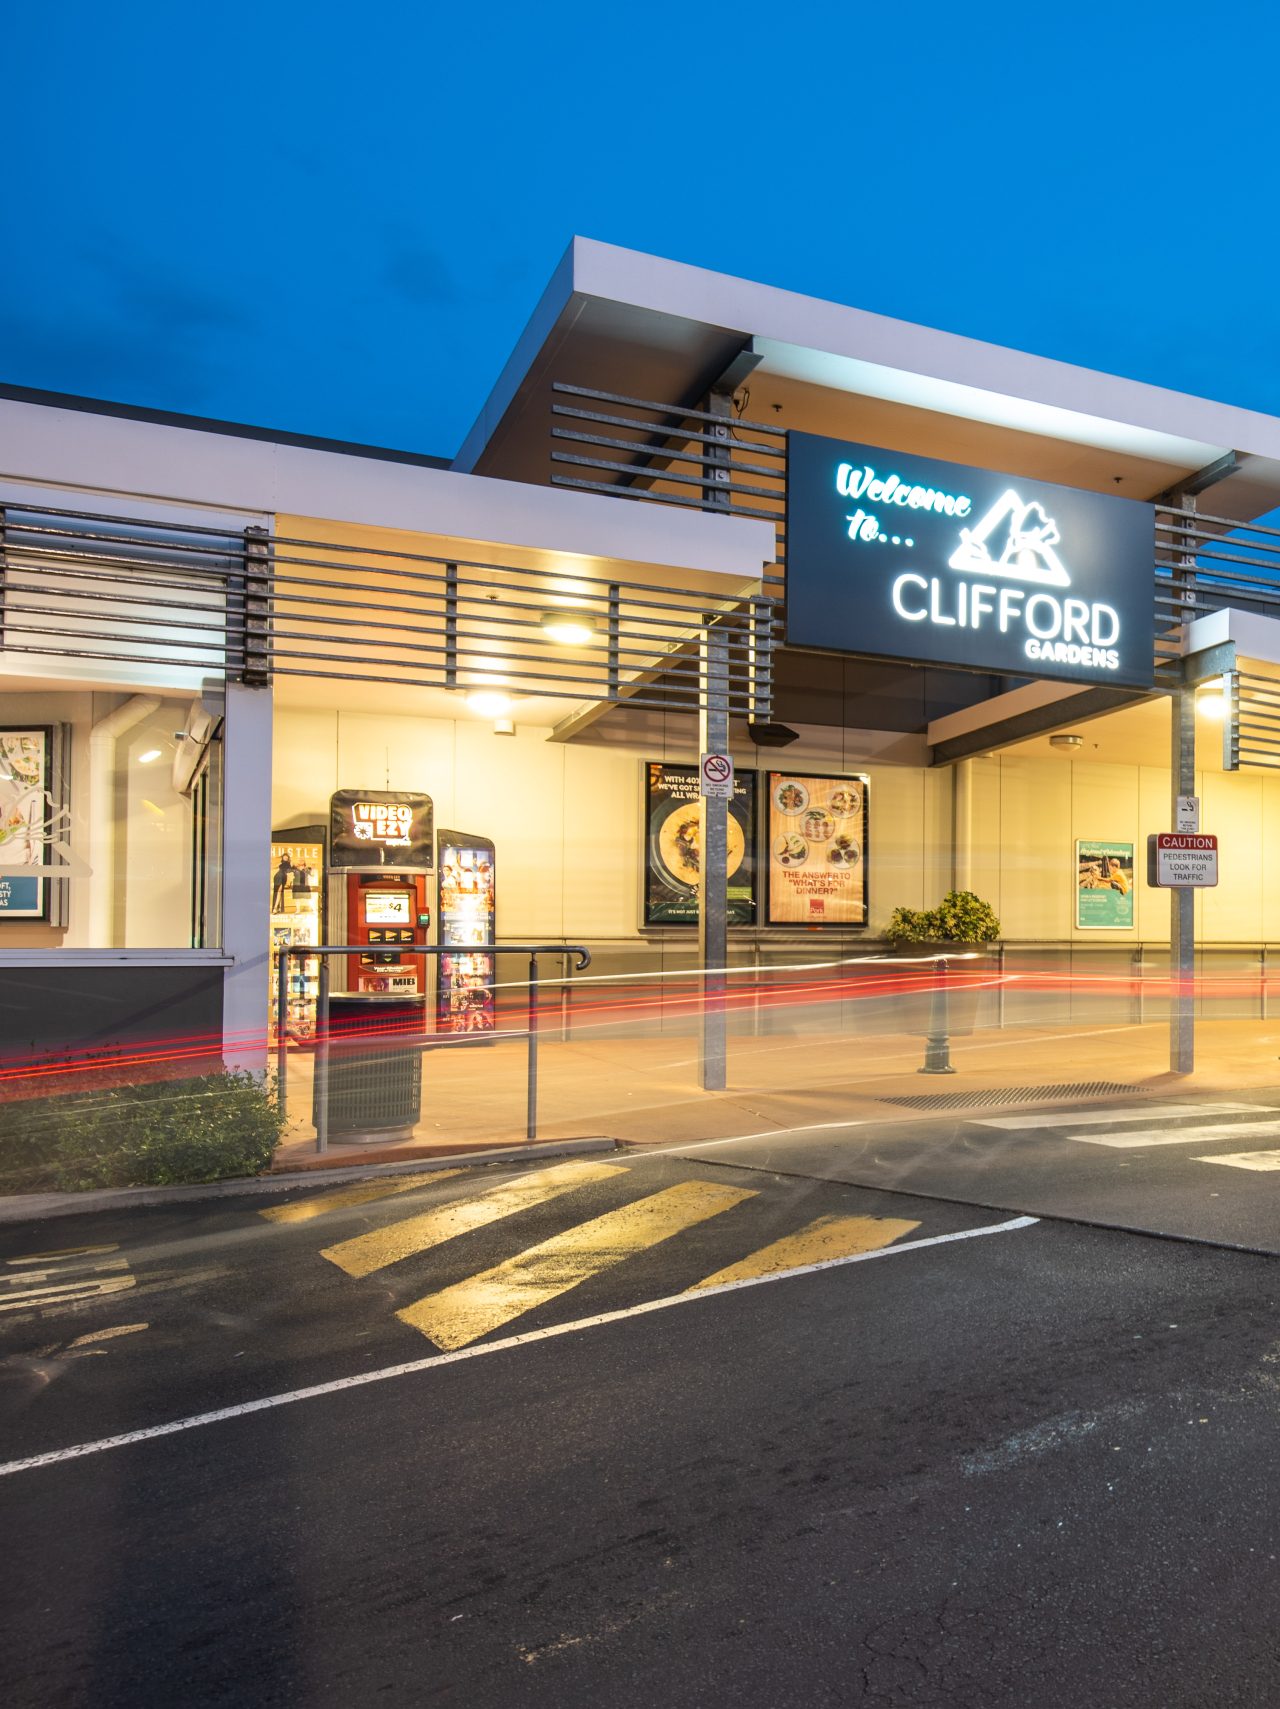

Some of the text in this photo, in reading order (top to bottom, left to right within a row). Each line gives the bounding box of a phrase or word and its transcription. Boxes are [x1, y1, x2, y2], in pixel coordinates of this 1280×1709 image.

[836, 462, 972, 518] Welcome
[892, 573, 1120, 646] CLIFFORD
[1025, 638, 1120, 669] GARDENS
[664, 776, 685, 784] WITH
[679, 784, 693, 792] GOT
[671, 791, 686, 799] ALL
[359, 805, 409, 821] VIDEO
[377, 821, 411, 836] EZY
[1162, 837, 1213, 848] CAUTION
[271, 847, 318, 858] HUSTLE
[1163, 853, 1213, 861] PEDESTRIANS
[782, 871, 800, 879] THE
[840, 872, 851, 880] TO
[1173, 873, 1204, 881] TRAFFIC
[796, 887, 838, 895] DINNER?"
[392, 978, 416, 986] MIB
